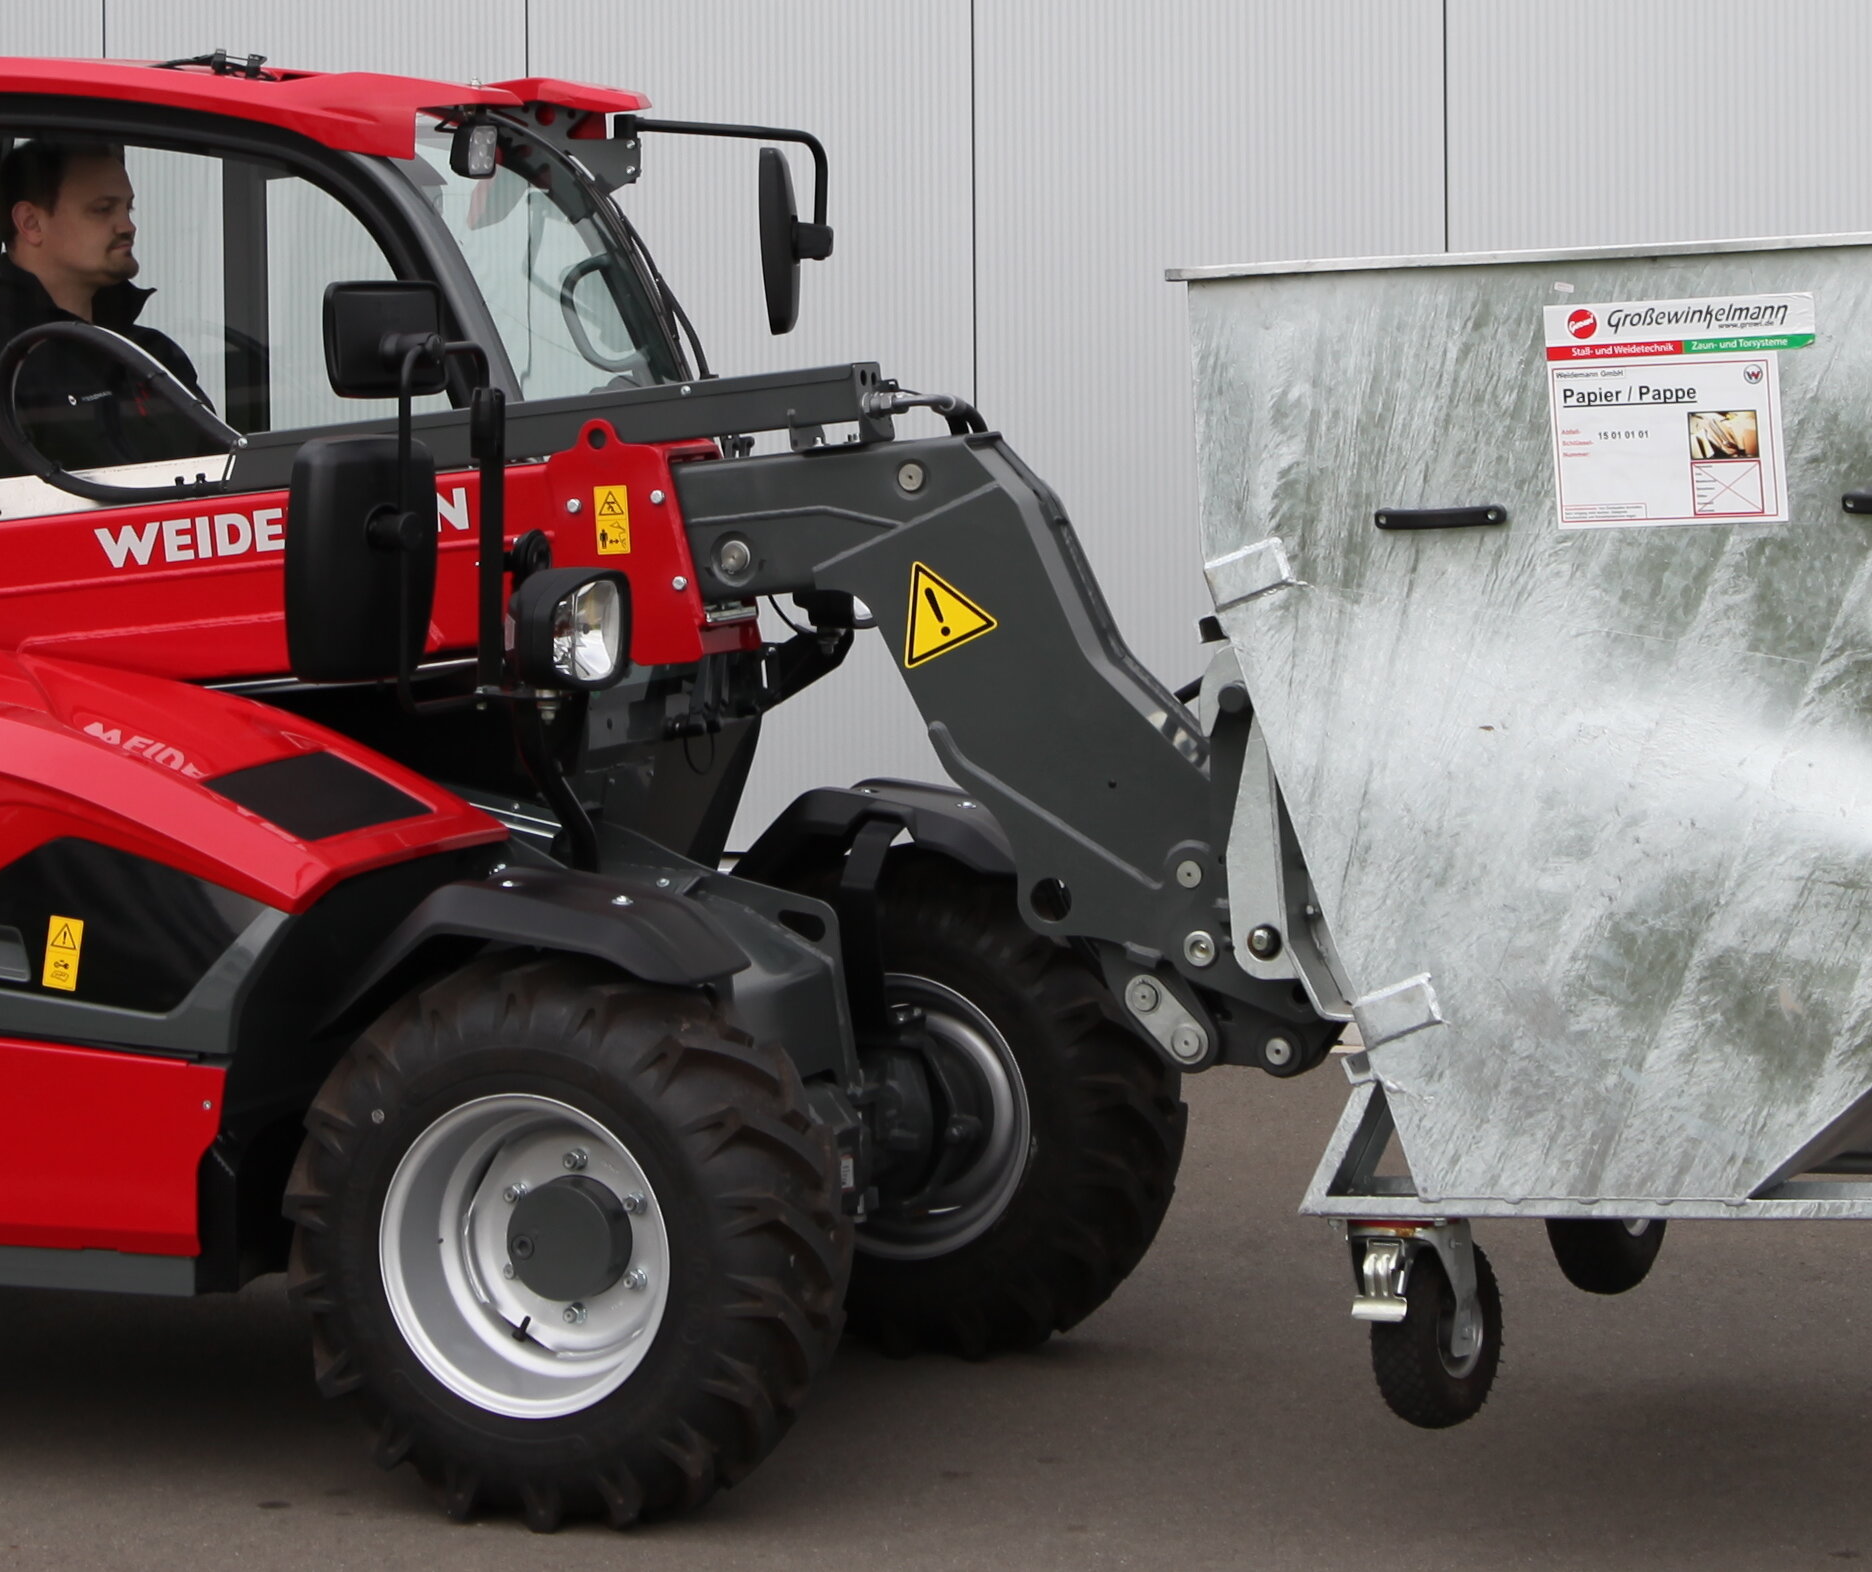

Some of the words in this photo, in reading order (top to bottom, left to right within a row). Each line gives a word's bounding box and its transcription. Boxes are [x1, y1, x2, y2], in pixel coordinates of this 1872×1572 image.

[1607, 304, 1788, 334] Großewinkelmann
[1571, 346, 1594, 357] Stall-
[1595, 346, 1613, 356] und
[1614, 342, 1674, 355] Weidetechnik
[1691, 340, 1718, 351] Zaun-
[1721, 338, 1737, 349] und
[1739, 337, 1788, 349] Torsysteme
[1556, 371, 1599, 379] Weidemann
[1600, 369, 1624, 377] GmbH
[1563, 387, 1622, 405] Papier
[1639, 384, 1697, 403] Pappe
[1598, 432, 1609, 440] 15
[1611, 431, 1622, 439] 01
[1625, 431, 1636, 439] 01
[1638, 430, 1649, 438] 01
[95, 488, 470, 568] WEIDEN
